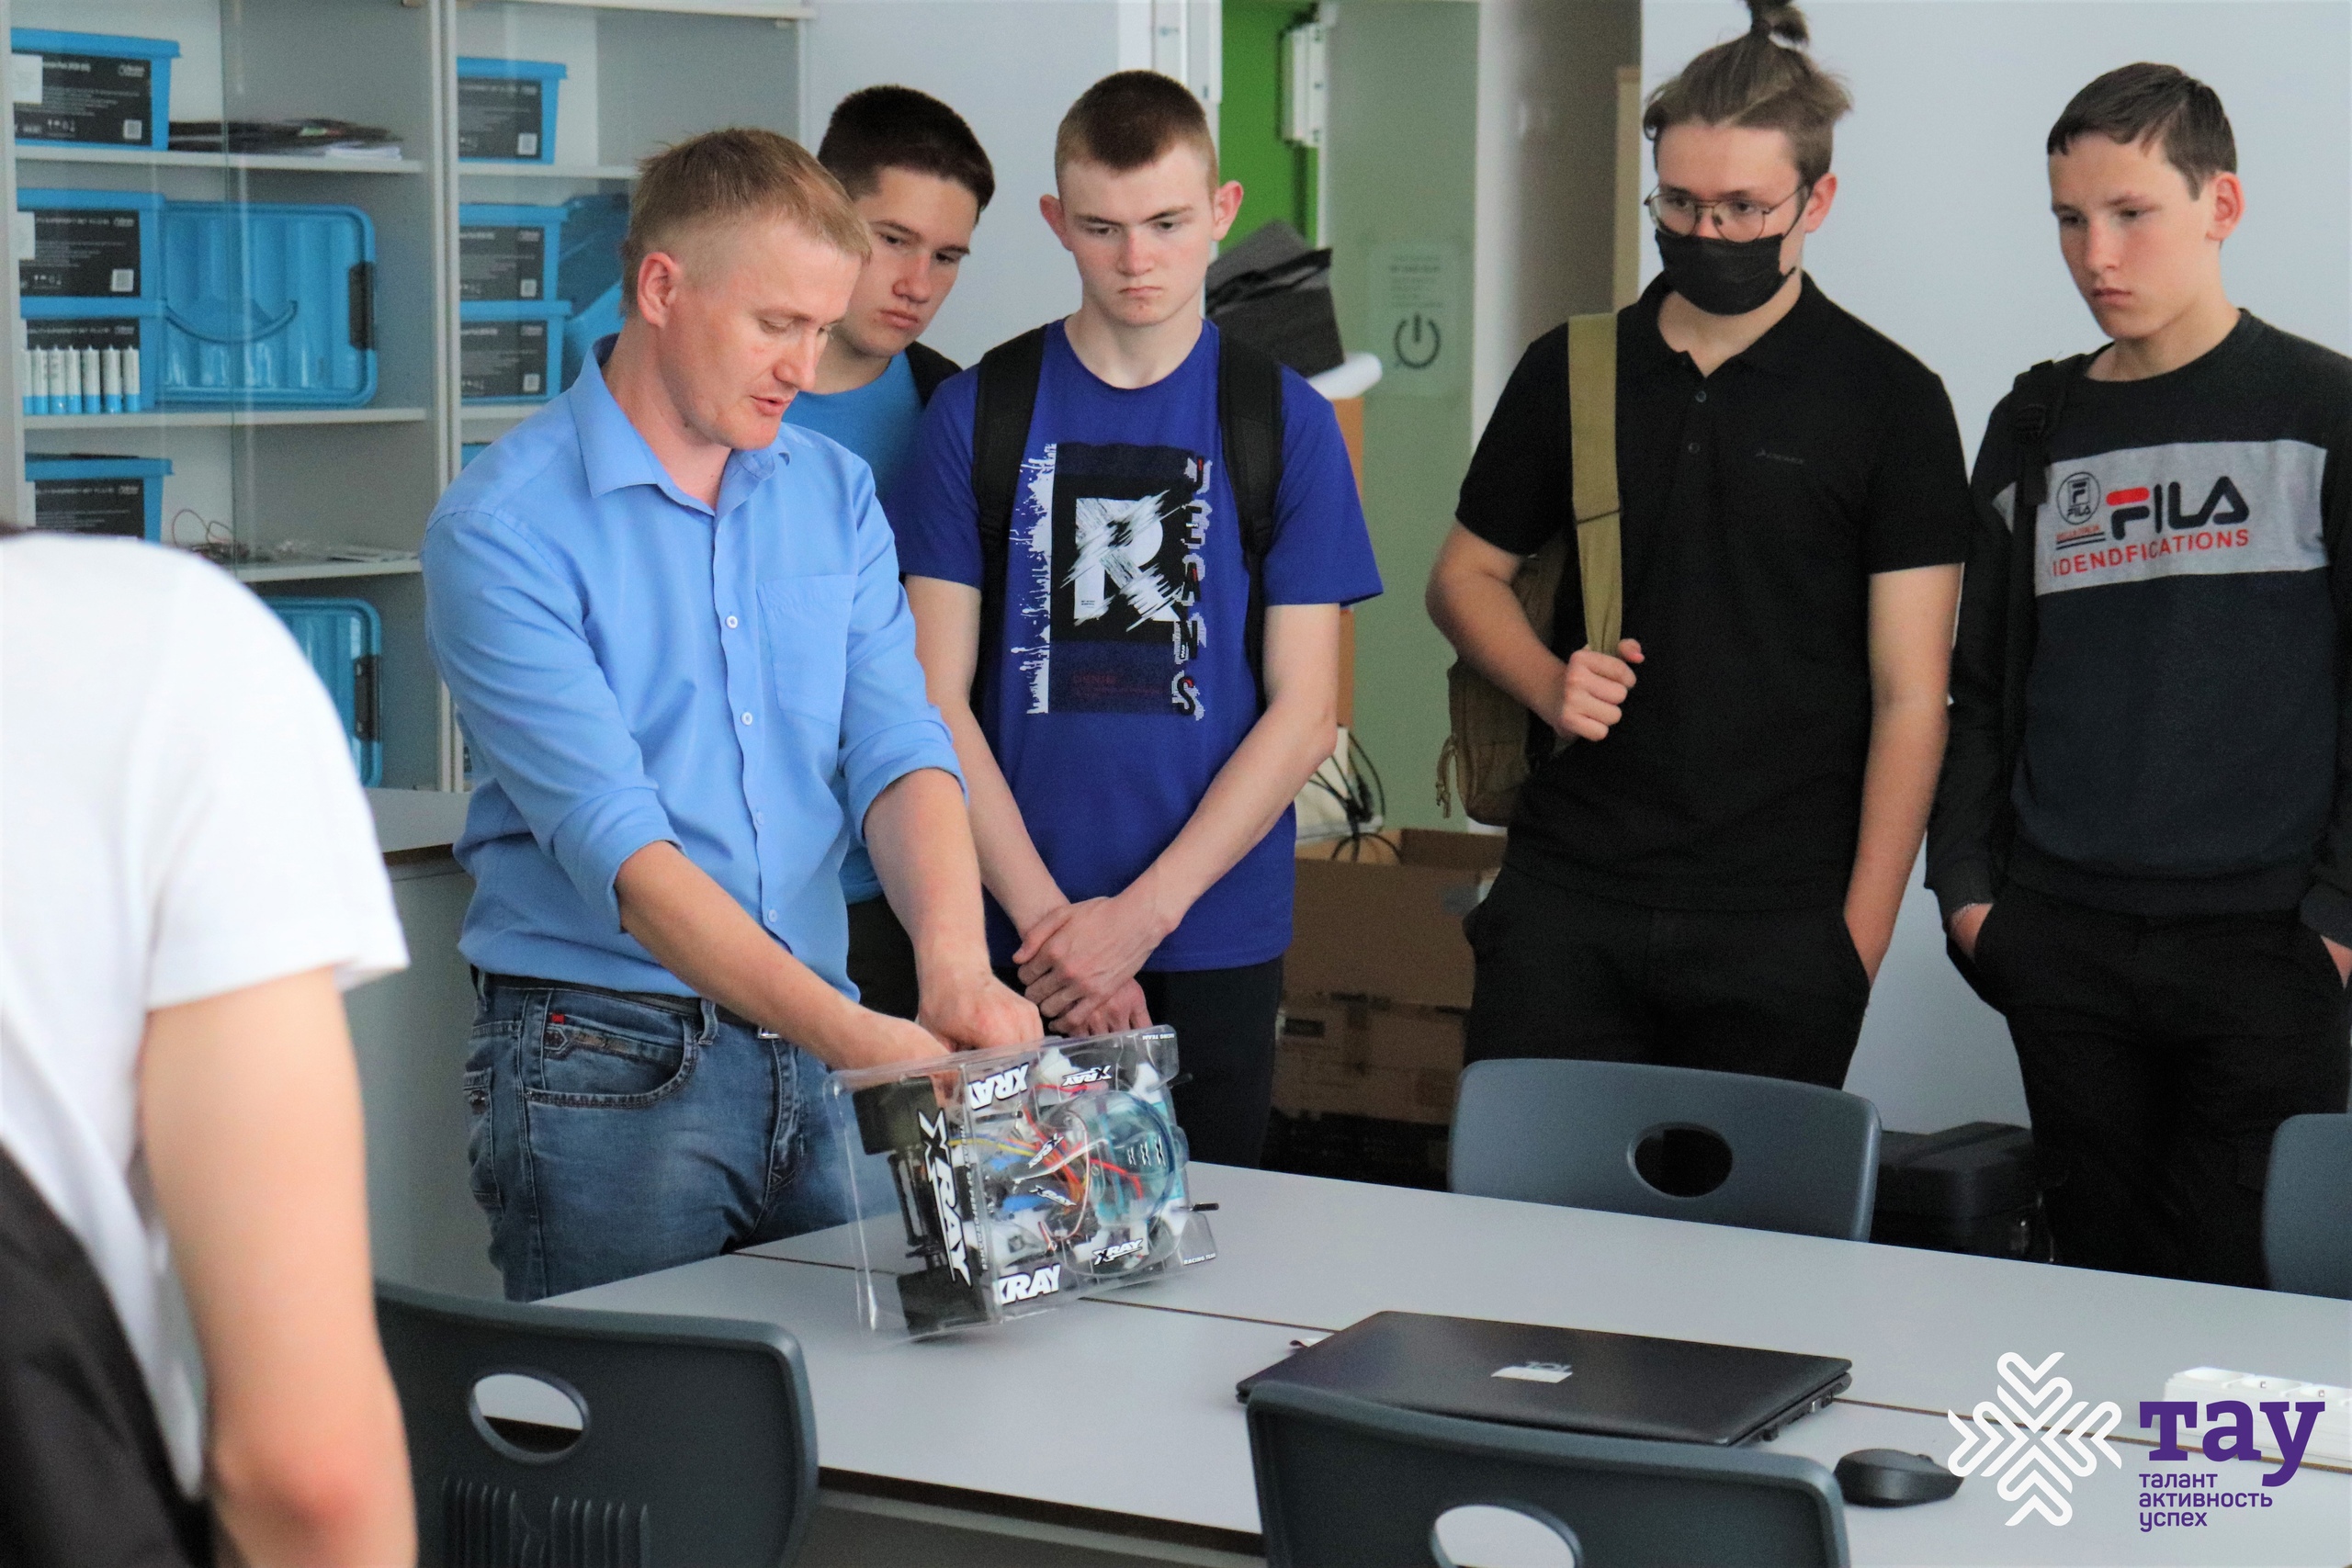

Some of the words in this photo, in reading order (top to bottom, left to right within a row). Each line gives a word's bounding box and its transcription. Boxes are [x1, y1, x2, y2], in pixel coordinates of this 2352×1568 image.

[2106, 475, 2250, 541] FILA
[1063, 492, 1182, 628] R
[2052, 529, 2250, 578] IDENDFICATIONS
[1061, 1064, 1113, 1087] XRAY
[918, 1108, 972, 1287] XRAY
[968, 1190, 988, 1270] PERFORMANCE
[1092, 1238, 1144, 1266] XRAY
[1183, 1255, 1205, 1265] RACING
